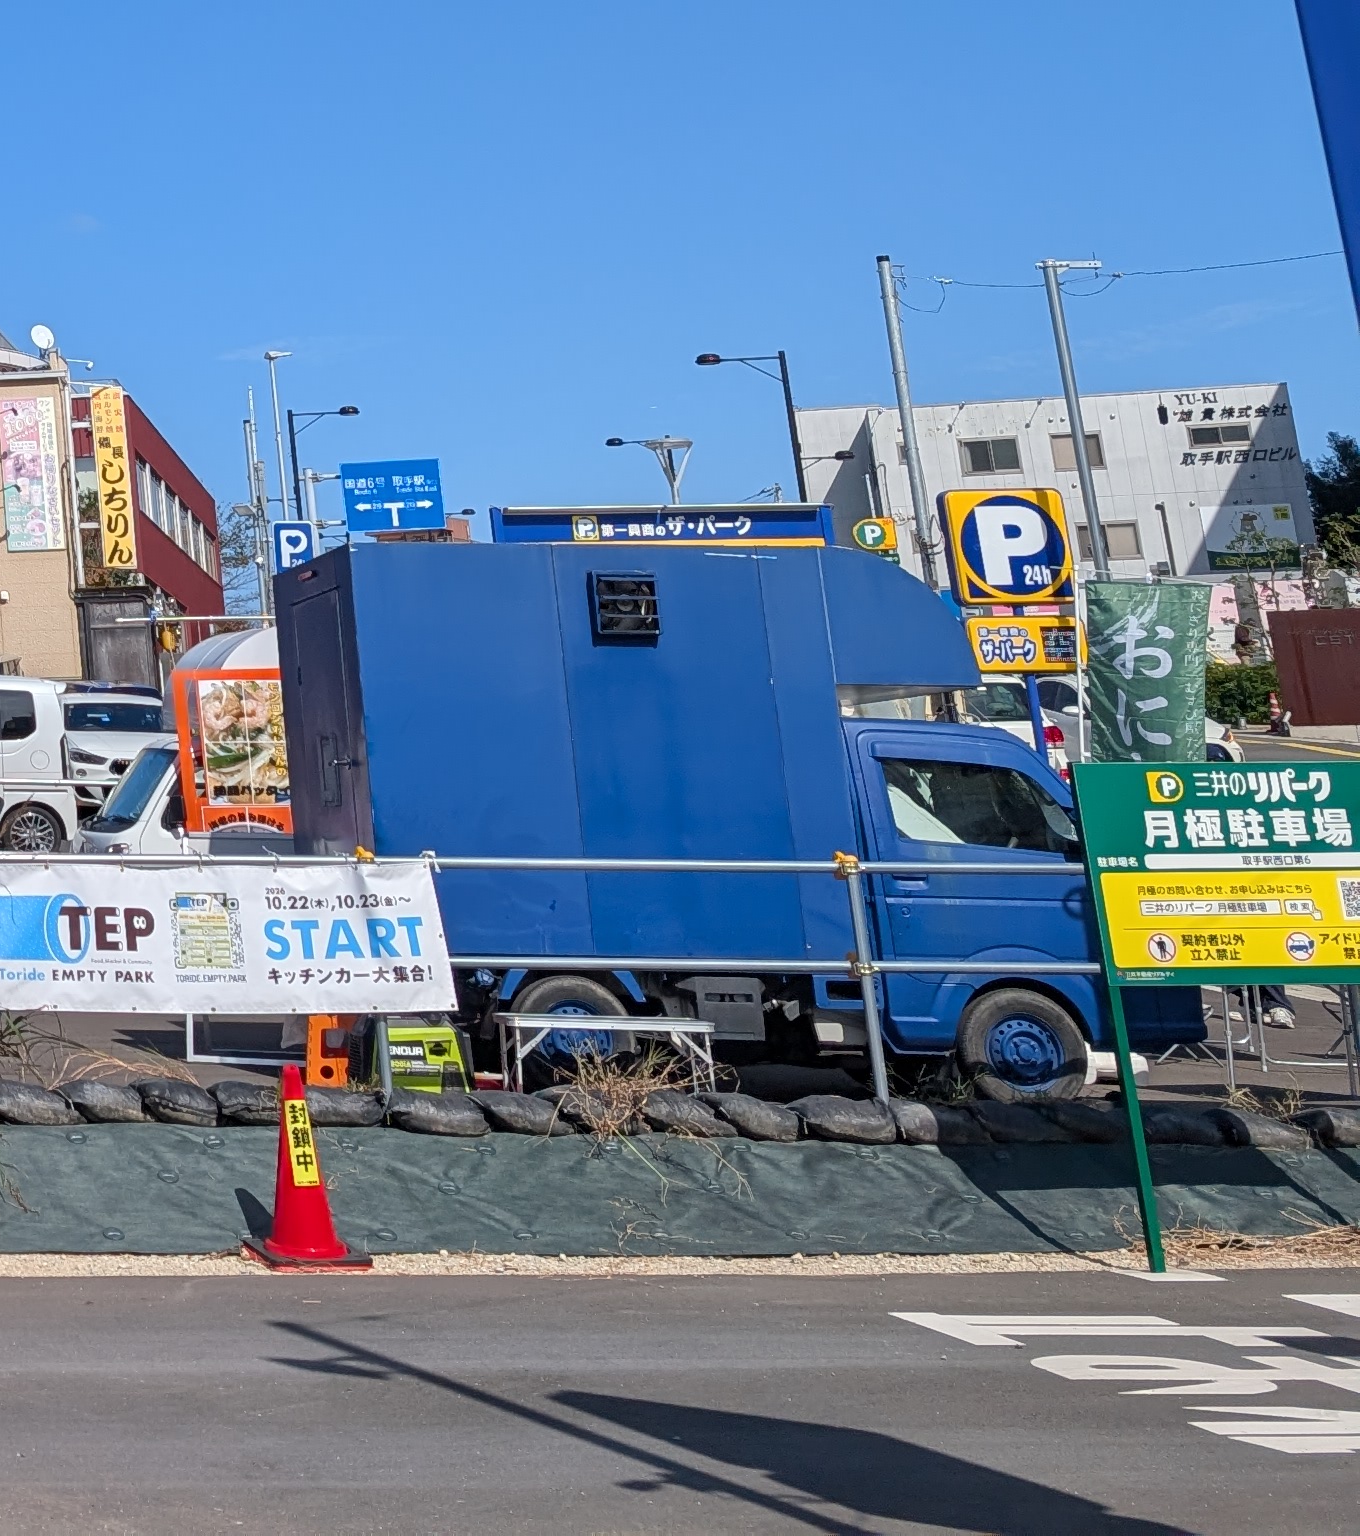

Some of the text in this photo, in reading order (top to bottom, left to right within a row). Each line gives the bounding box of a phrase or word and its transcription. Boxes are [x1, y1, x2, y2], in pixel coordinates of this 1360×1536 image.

[1174, 392, 1218, 405] YU-KI
[1180, 447, 1297, 467] 取手駅西口ビル
[344, 477, 385, 489] 国道6号
[864, 525, 881, 545] P
[974, 506, 1047, 586] P
[1023, 565, 1053, 586] 24h
[980, 639, 1035, 662] ザ・パーク
[1112, 616, 1175, 762] おに
[1193, 768, 1331, 803] 三井のリパーク
[1144, 807, 1354, 848] 月極駐車場
[1097, 856, 1139, 868] 駐車場名
[1242, 854, 1312, 866] 取手駅西口第6
[265, 887, 285, 895] 2026
[1144, 901, 1267, 914] 三井のリパーク 月極駐車場
[59, 906, 155, 952] TEP
[264, 916, 423, 961] START
[1181, 933, 1246, 947] 契約者以外
[1190, 949, 1242, 962] 立入禁止
[1343, 947, 1360, 960] 禁
[52, 969, 108, 982] EMPTY
[115, 970, 155, 983] PARK
[288, 1103, 314, 1173] 封鎖中
